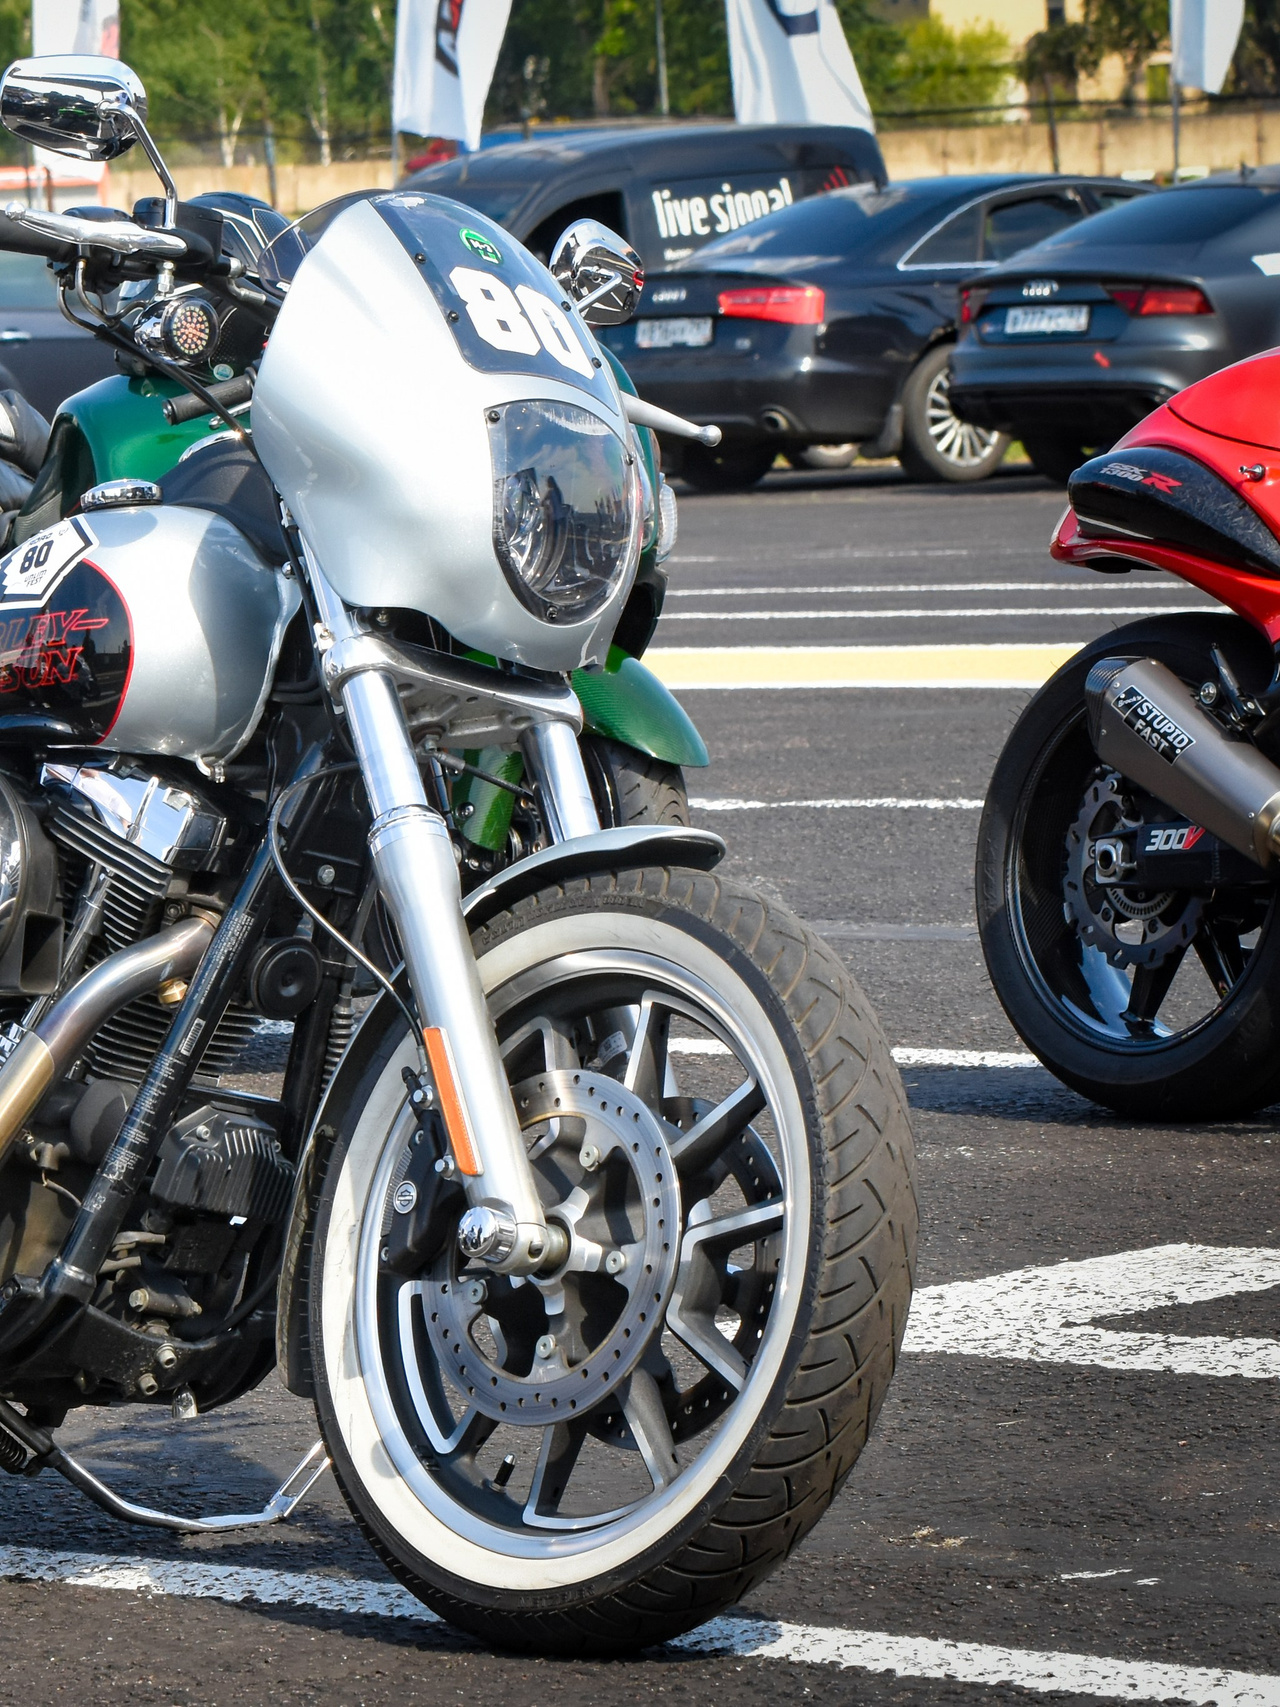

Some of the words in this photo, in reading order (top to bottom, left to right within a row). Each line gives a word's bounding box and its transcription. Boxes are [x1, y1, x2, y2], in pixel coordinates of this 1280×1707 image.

[651, 188, 711, 238] live
[448, 265, 596, 381] 80
[1099, 467, 1145, 482] 1300
[19, 539, 55, 575] 80
[1133, 718, 1170, 753] FAST
[1136, 701, 1189, 749] STUPID
[1144, 825, 1207, 852] 300V
